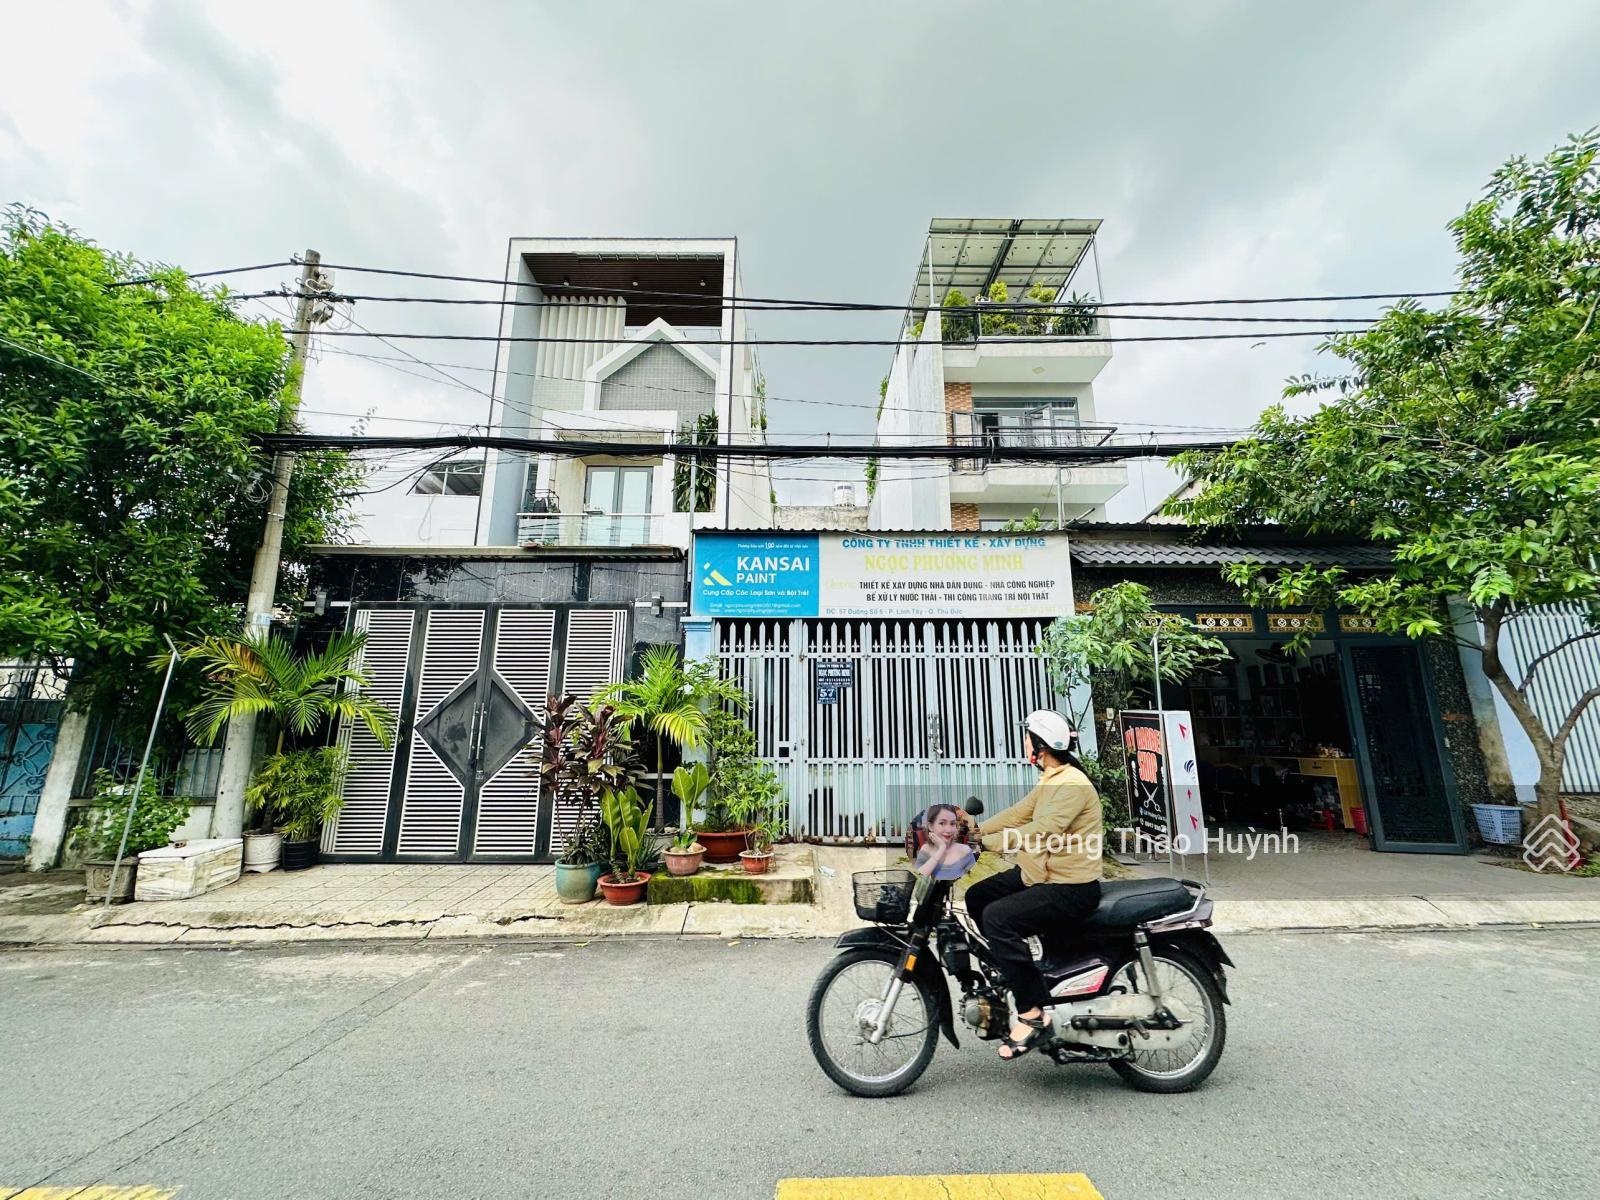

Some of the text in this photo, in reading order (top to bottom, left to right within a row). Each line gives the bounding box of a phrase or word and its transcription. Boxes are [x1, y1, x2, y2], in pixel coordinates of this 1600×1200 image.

[842, 536, 873, 548] CÔNG
[876, 538, 891, 548] TY
[895, 539, 924, 548] TNHH
[989, 537, 1011, 548] XÂY
[736, 556, 810, 571] KANSAI
[736, 573, 777, 584] PAINT
[859, 580, 879, 589] THIẾT
[892, 580, 906, 589] XÂY
[930, 580, 945, 589] NHÀ
[946, 580, 961, 589] DÂN
[990, 580, 1005, 589] NHÀ
[1006, 580, 1026, 589] CÔNG
[1028, 579, 1055, 589] NGHIỆP
[957, 592, 977, 601] CÔNG
[820, 689, 834, 697] 57
